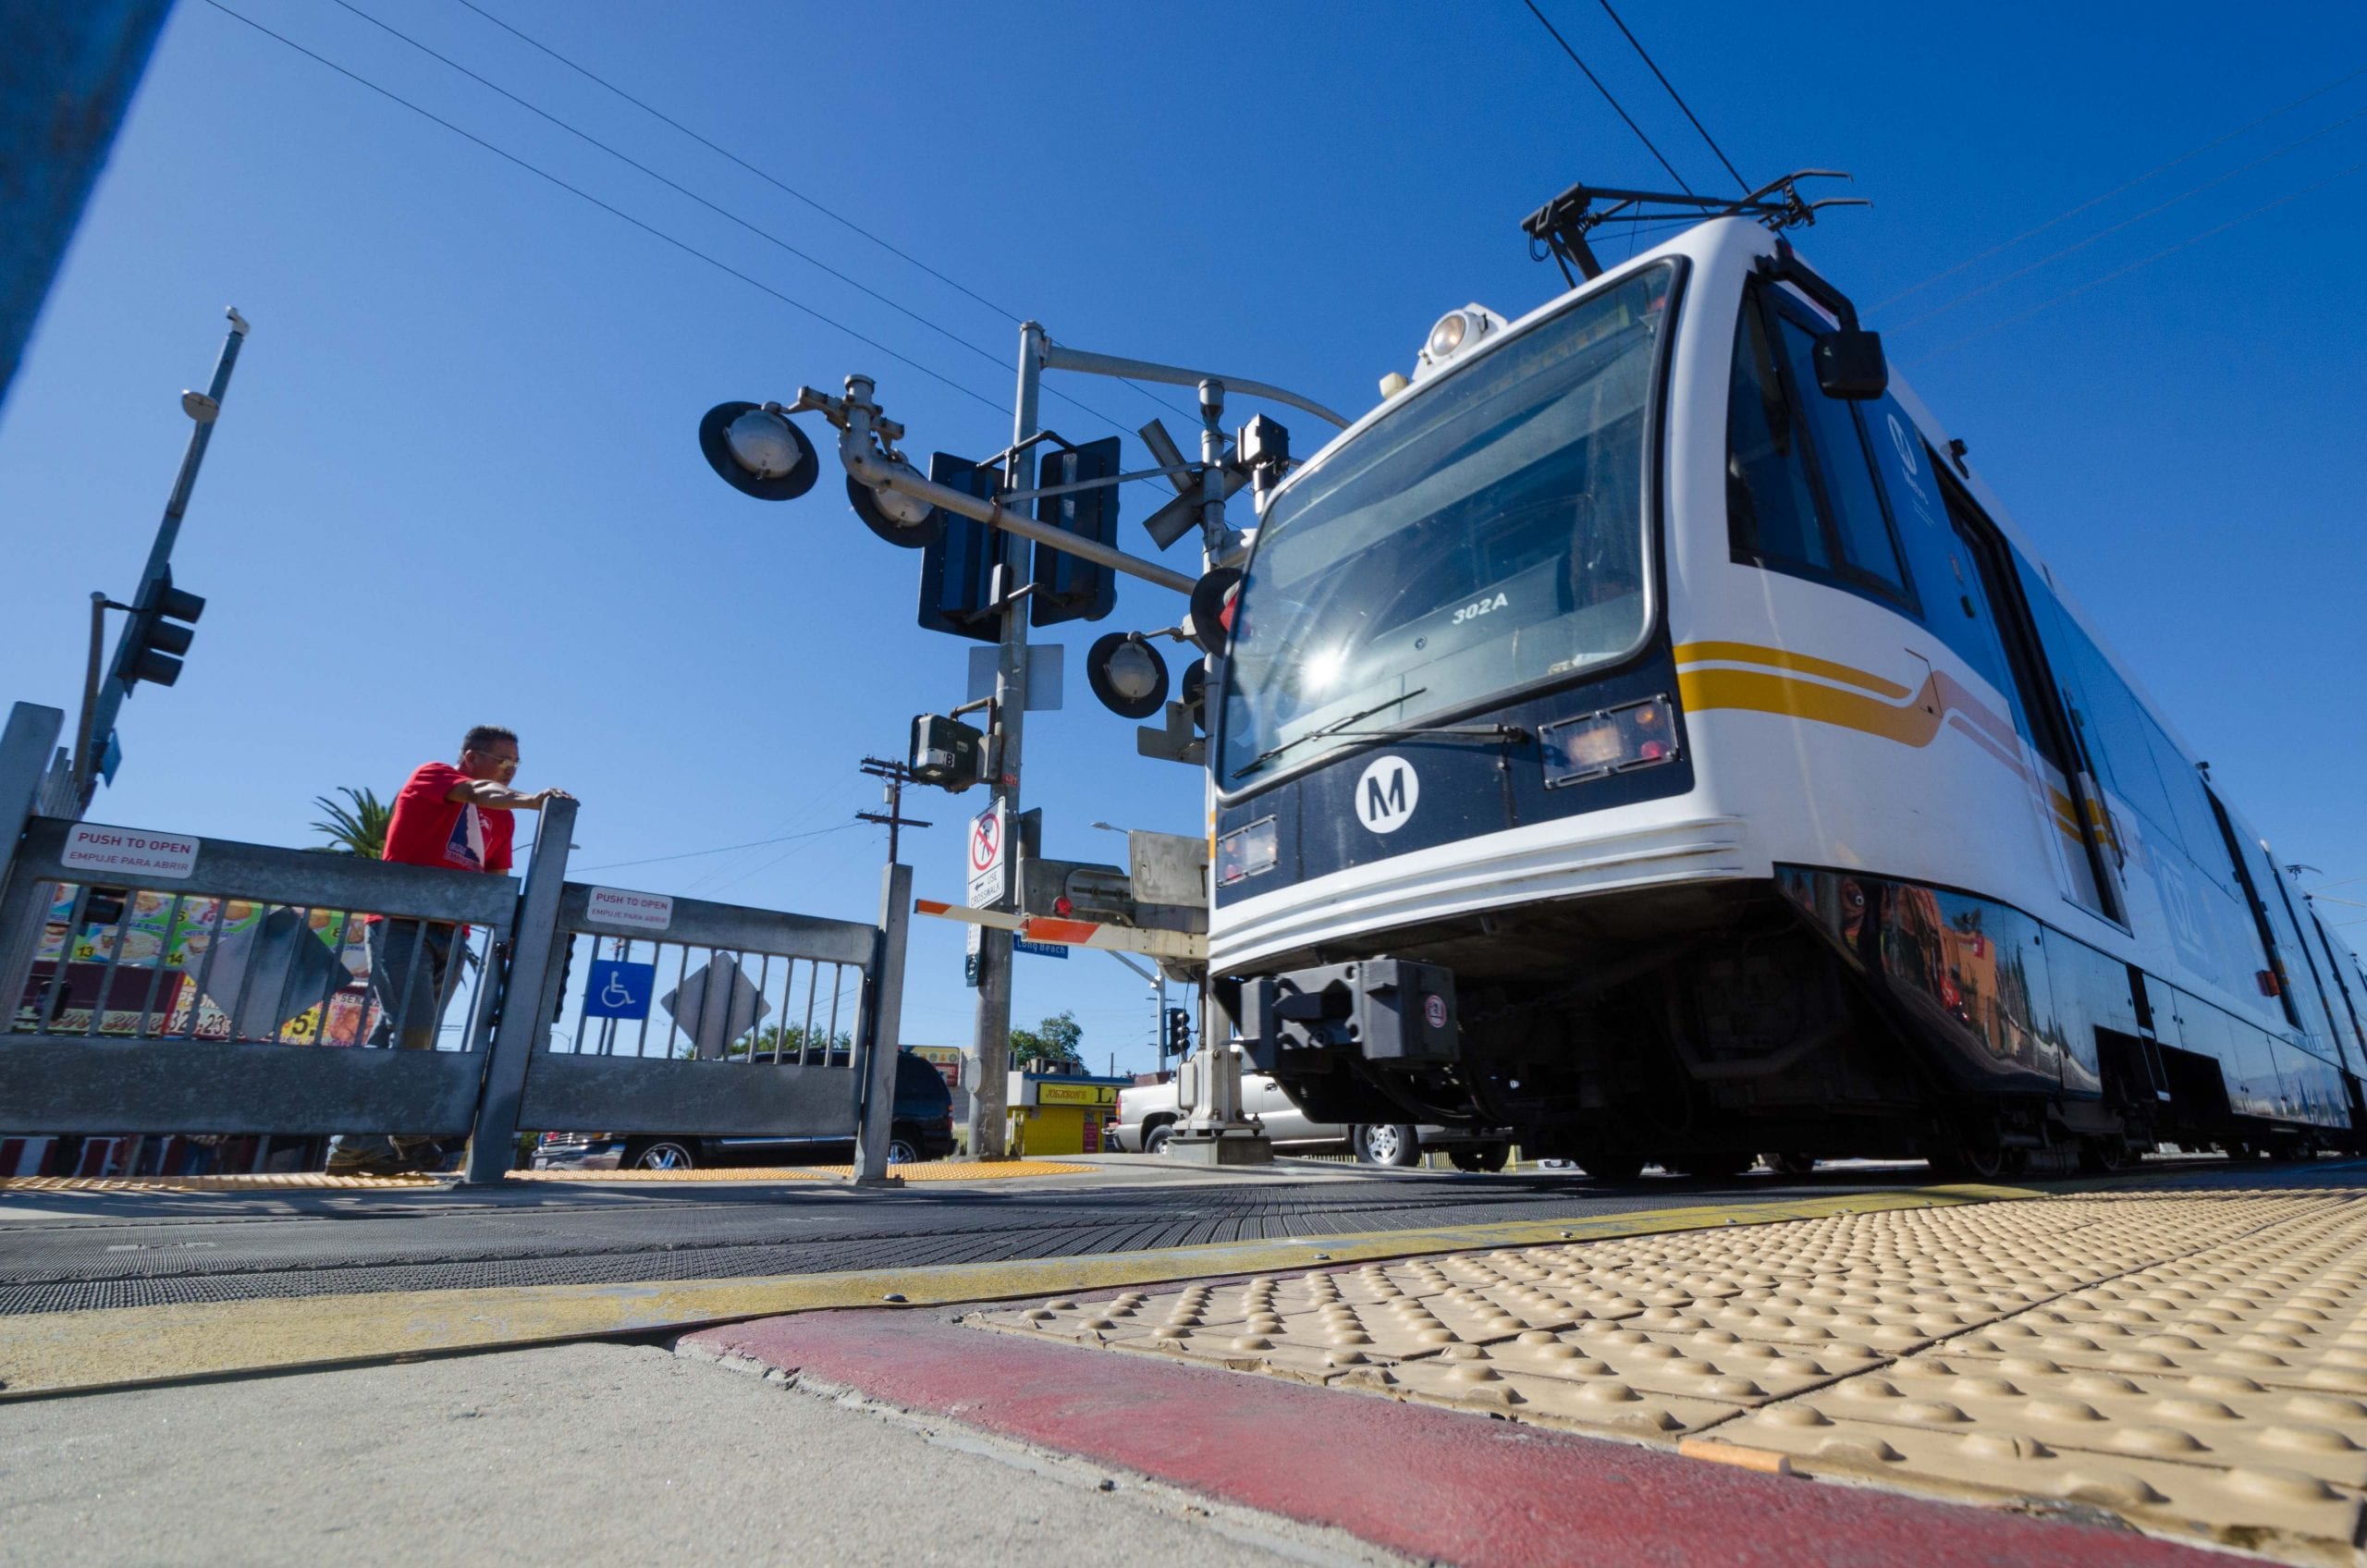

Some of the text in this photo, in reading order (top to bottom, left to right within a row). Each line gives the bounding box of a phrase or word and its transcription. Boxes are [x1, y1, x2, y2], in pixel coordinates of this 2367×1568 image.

[1452, 592, 1508, 624] 302A
[1367, 767, 1406, 821] M
[78, 832, 191, 854] PUSH TO OPEN
[69, 851, 189, 871] EMPUJE PARA ABRIR
[986, 870, 998, 885] USE
[596, 893, 668, 911] PUSH TO OPEN
[970, 881, 1000, 906] CROSSWALK
[592, 908, 622, 919] EMPUJE
[623, 913, 643, 921] PARA
[78, 946, 93, 957] 13
[1017, 938, 1065, 954] Long Beach
[167, 953, 184, 963] 14
[1046, 1088, 1086, 1100] JOHNSON'S
